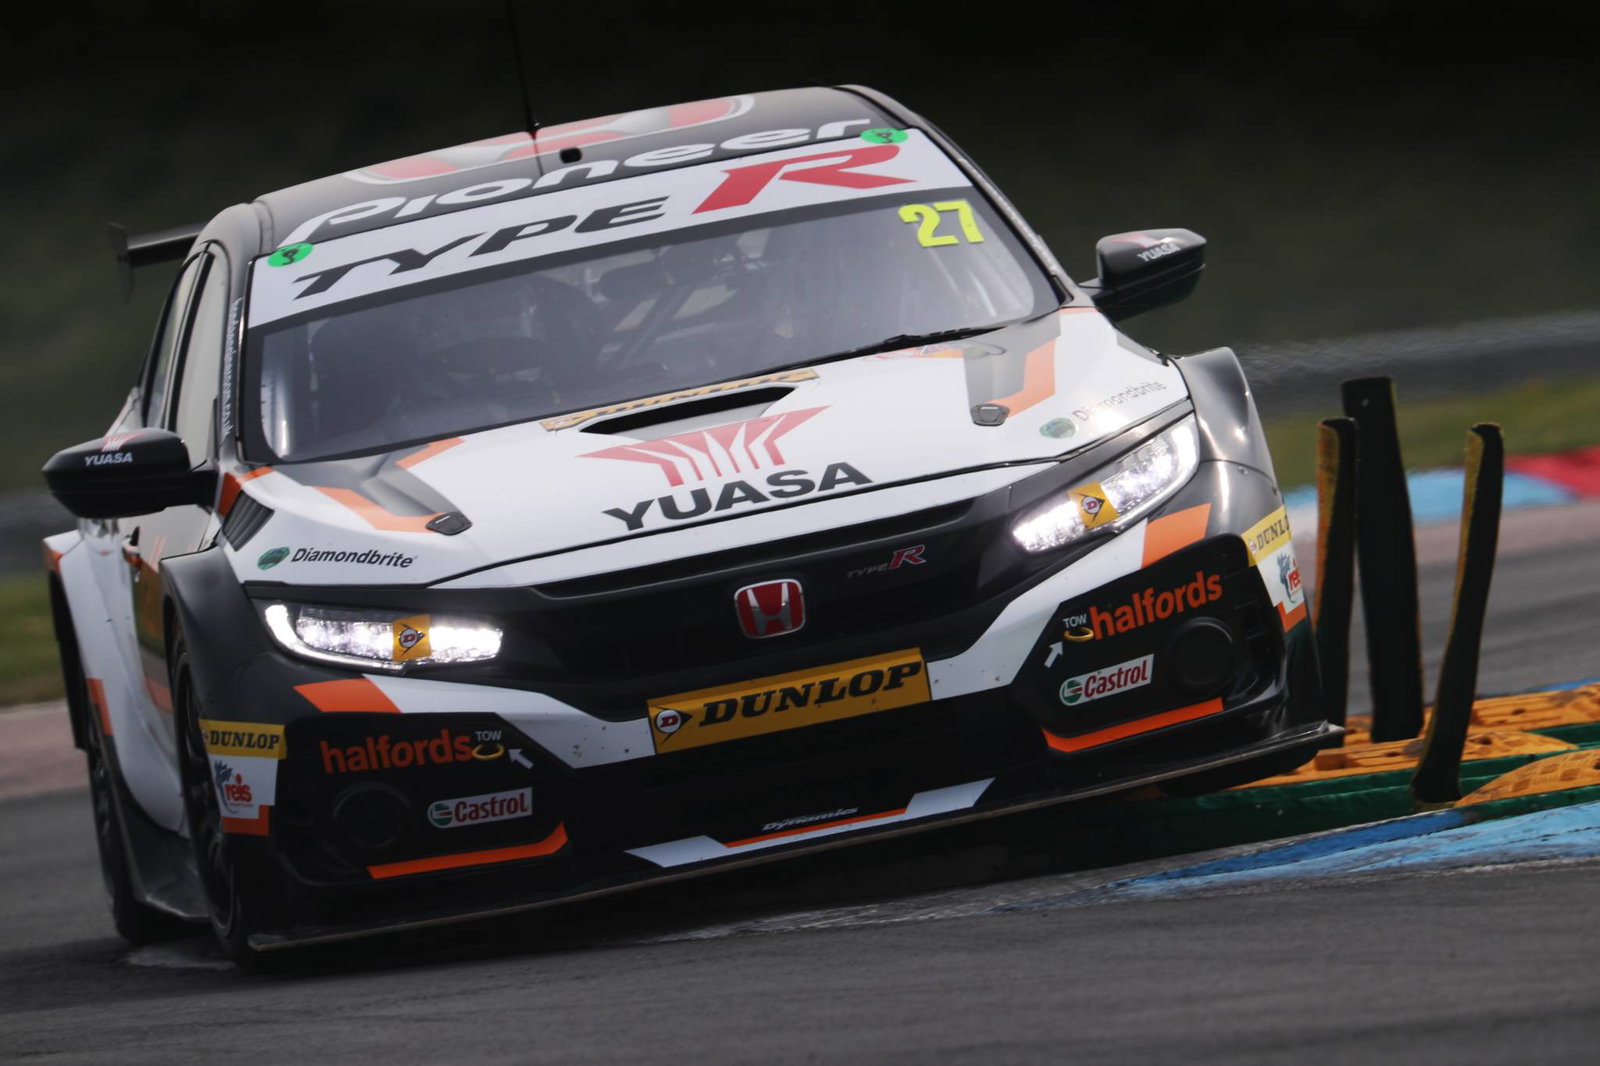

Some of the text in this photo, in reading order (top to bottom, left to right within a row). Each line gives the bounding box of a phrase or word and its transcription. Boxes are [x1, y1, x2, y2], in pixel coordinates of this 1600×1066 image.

[277, 118, 869, 247] pioneer
[292, 196, 670, 300] TYPE
[692, 144, 917, 214] R
[898, 199, 984, 247] 27
[1136, 243, 1181, 262] YUASA
[84, 452, 133, 466] YUASA
[602, 461, 873, 531] YUASA
[290, 547, 412, 569] Diamondbrite
[847, 544, 926, 578] TYPE R
[1063, 613, 1088, 629] TOW
[1090, 571, 1223, 640] halfords
[699, 660, 922, 728] DUNLOP
[1084, 660, 1149, 698] Castrol
[210, 730, 279, 750] DUNLOP
[320, 728, 473, 775] halfords
[475, 731, 502, 742] TOW
[455, 792, 528, 825] Castrol
